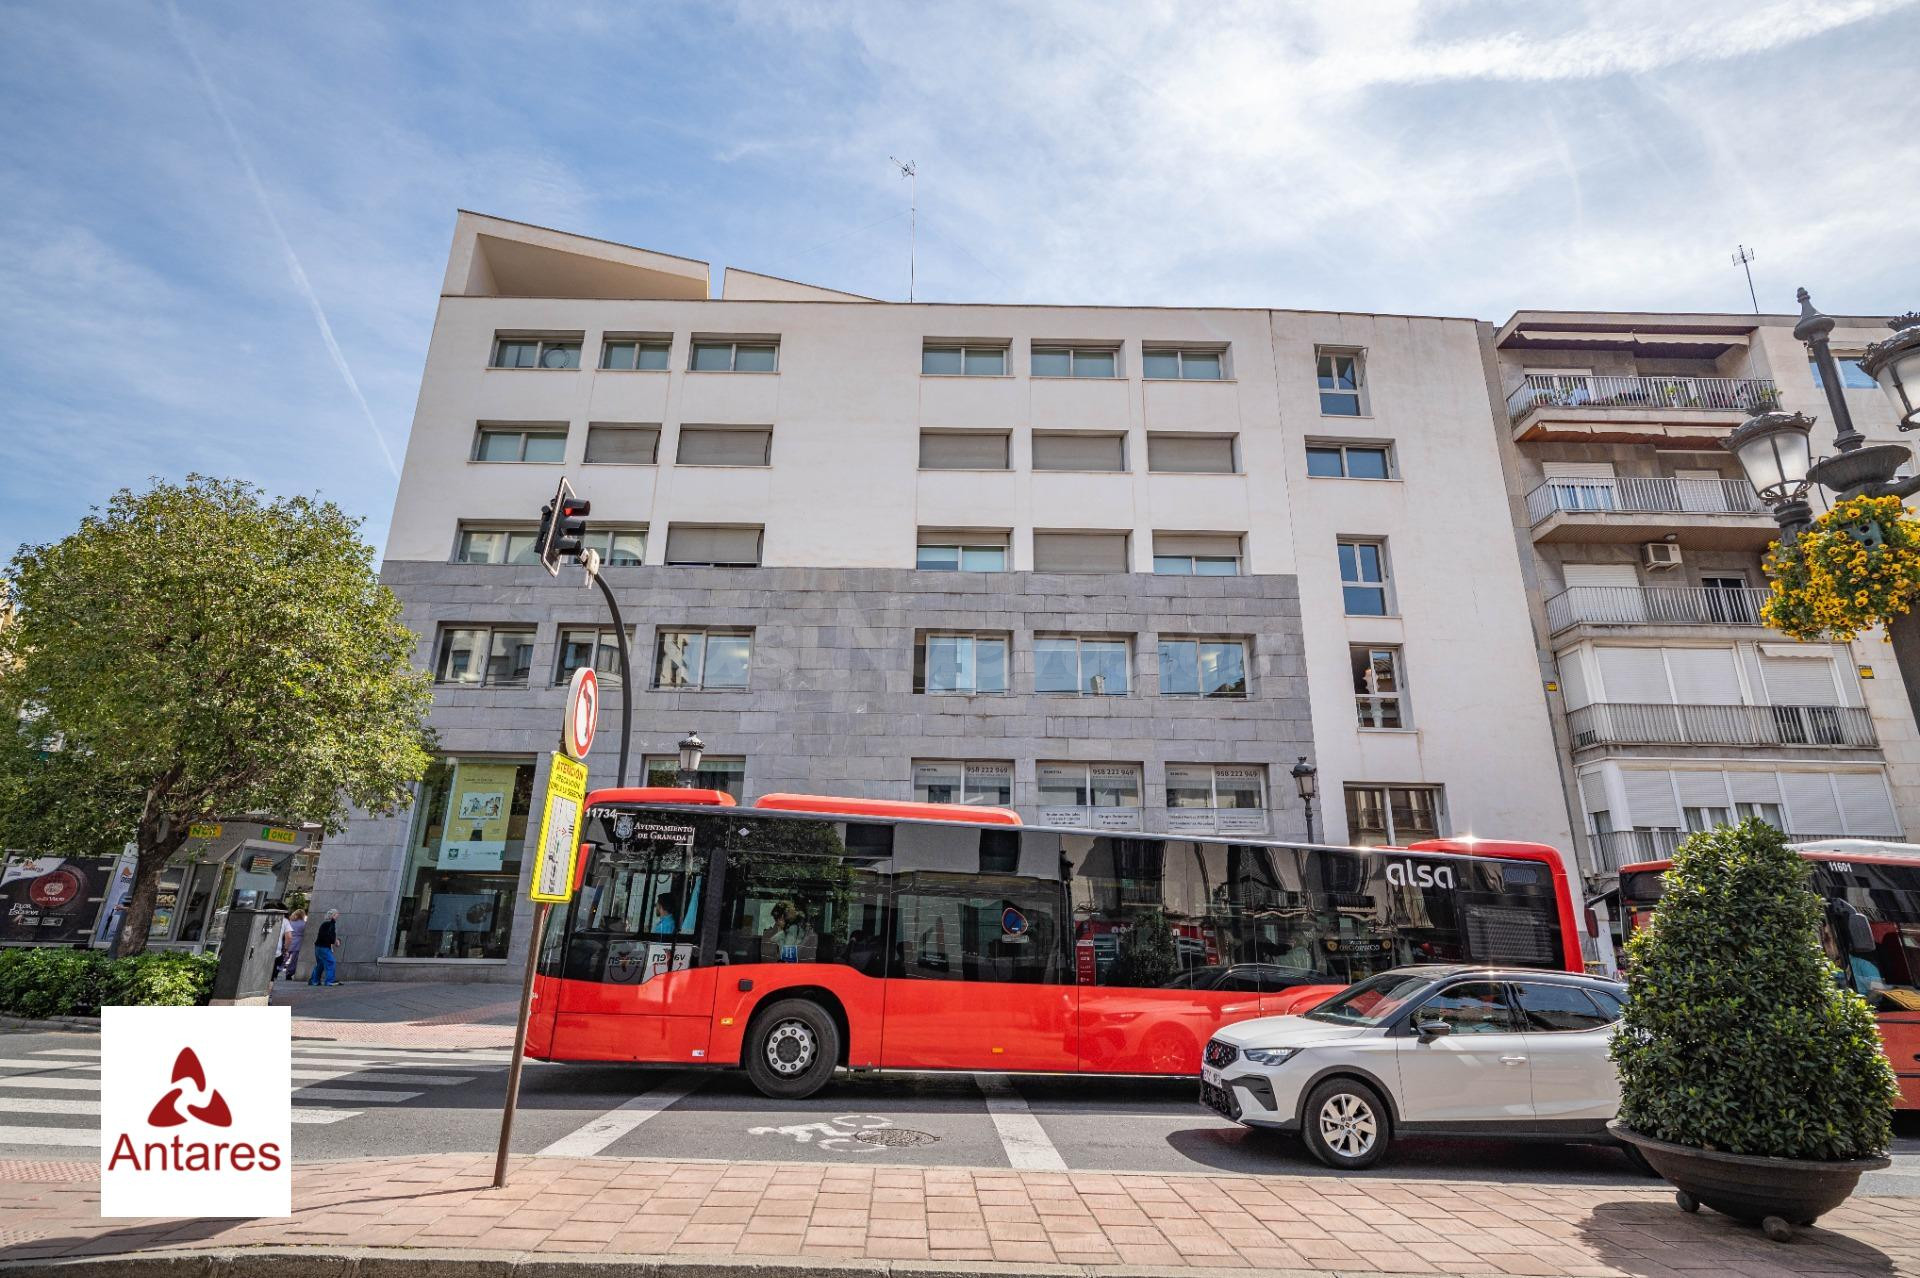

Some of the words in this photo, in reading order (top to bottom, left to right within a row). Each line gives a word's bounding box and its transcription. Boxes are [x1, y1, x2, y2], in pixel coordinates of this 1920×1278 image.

[586, 808, 617, 818] 11734
[633, 822, 693, 833] AYUNTAMIENTO
[271, 831, 292, 841] ONCE
[650, 831, 687, 841] GRANADA
[1828, 861, 1853, 873] 11601
[1386, 859, 1454, 889] alsa
